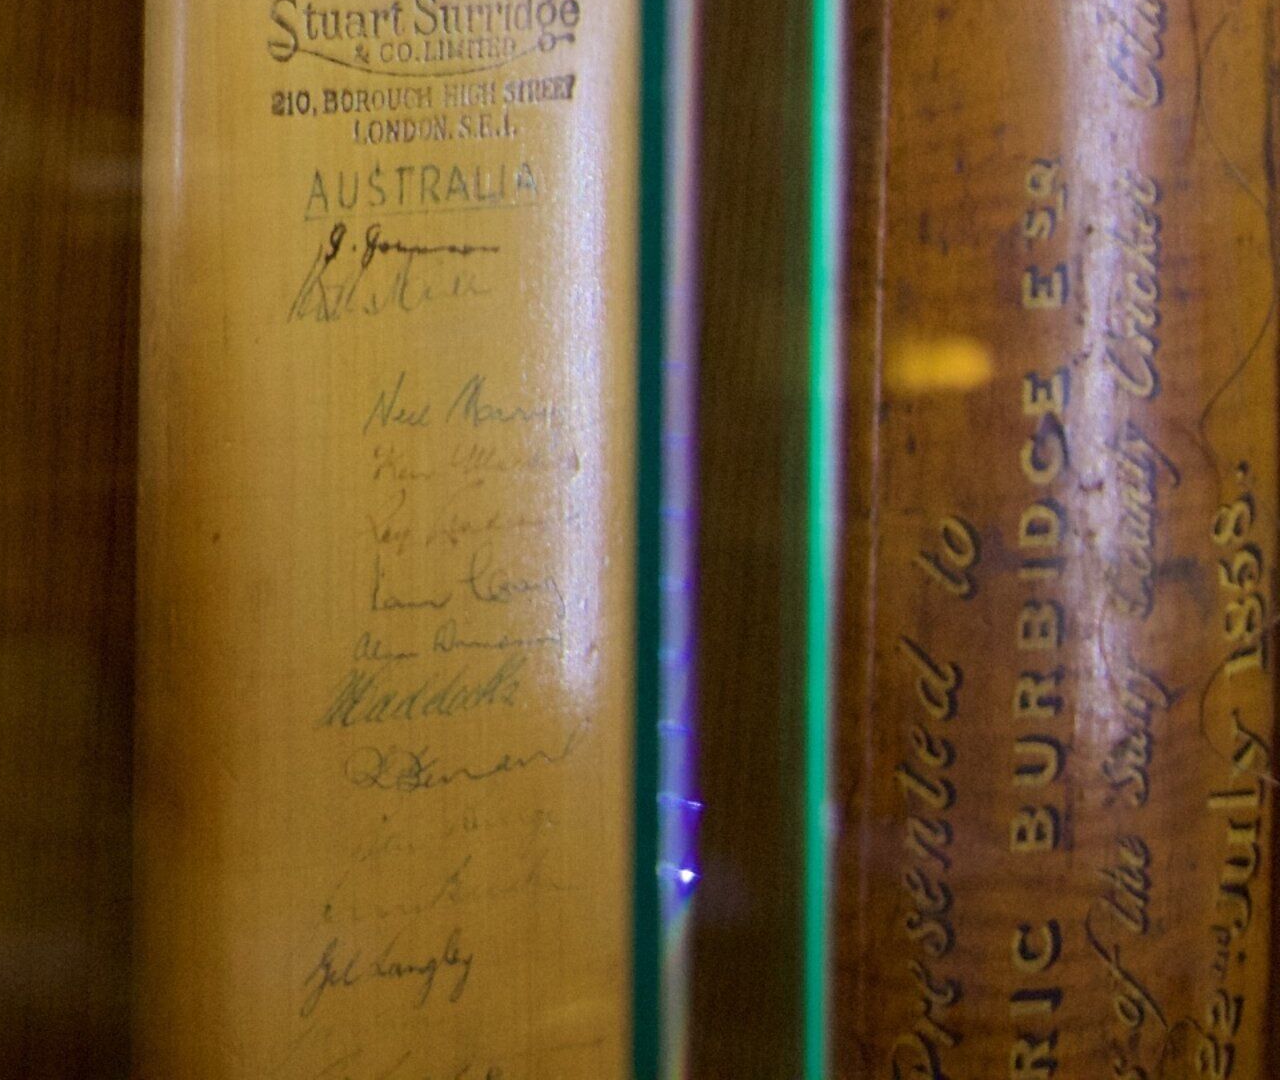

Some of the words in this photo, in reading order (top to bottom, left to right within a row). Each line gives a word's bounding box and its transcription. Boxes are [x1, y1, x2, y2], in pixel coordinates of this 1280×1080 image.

[322, 84, 434, 114] BOROUGH
[443, 78, 497, 108] HIGH
[354, 44, 371, 64] &
[305, 158, 540, 214] AUSTRALIA
[1104, 169, 1162, 401] Cricket
[914, 514, 982, 602] to
[1104, 420, 1182, 622] County
[1010, 366, 1074, 852] BURBIDGE
[890, 635, 966, 1080] Presented
[1098, 833, 1153, 936] the
[1206, 708, 1272, 934] July
[1085, 904, 1170, 1032] of
